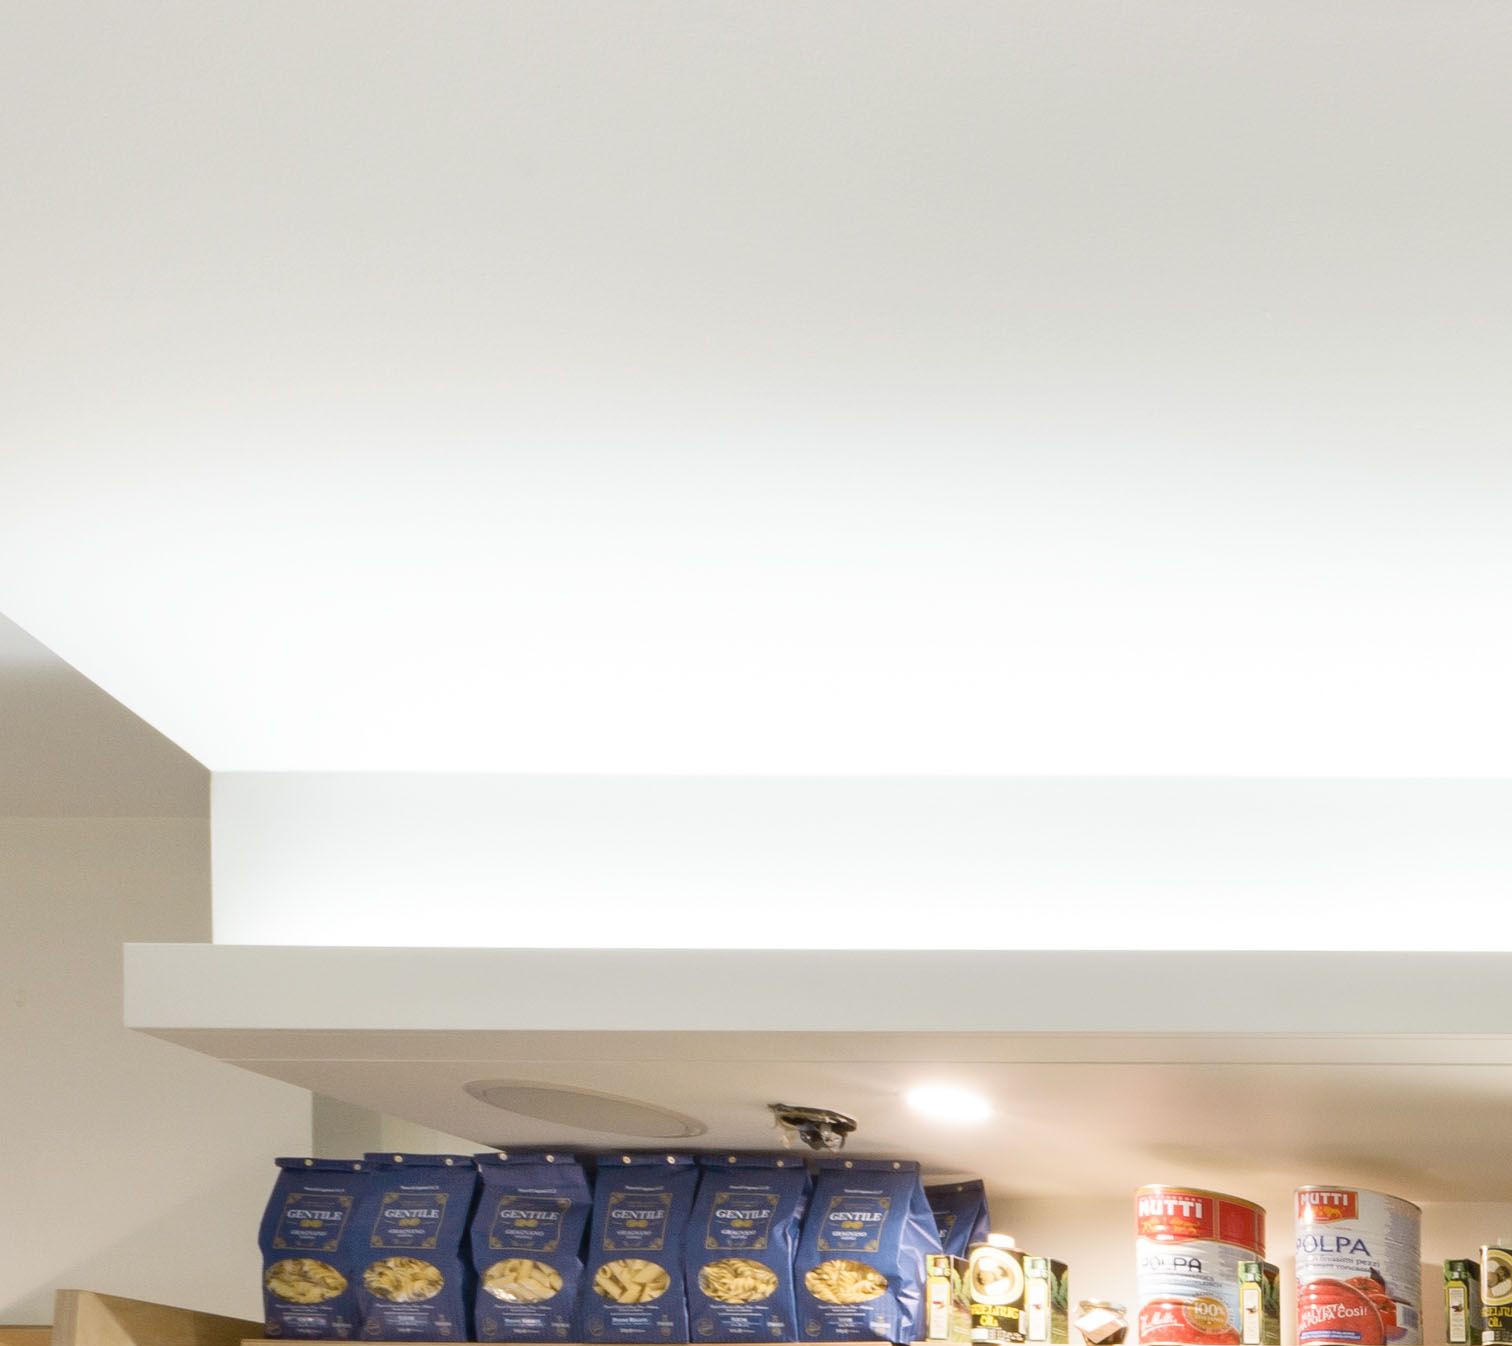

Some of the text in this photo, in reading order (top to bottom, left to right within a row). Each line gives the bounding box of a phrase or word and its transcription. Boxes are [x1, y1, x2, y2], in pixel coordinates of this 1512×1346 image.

[1300, 1192, 1348, 1206] MUTTI
[286, 1208, 343, 1222] GENTILE
[501, 1208, 558, 1222] GENTILE
[716, 1208, 769, 1222] GENTILE
[1139, 1199, 1202, 1218] MUTTI
[829, 1211, 883, 1223] GENTILE
